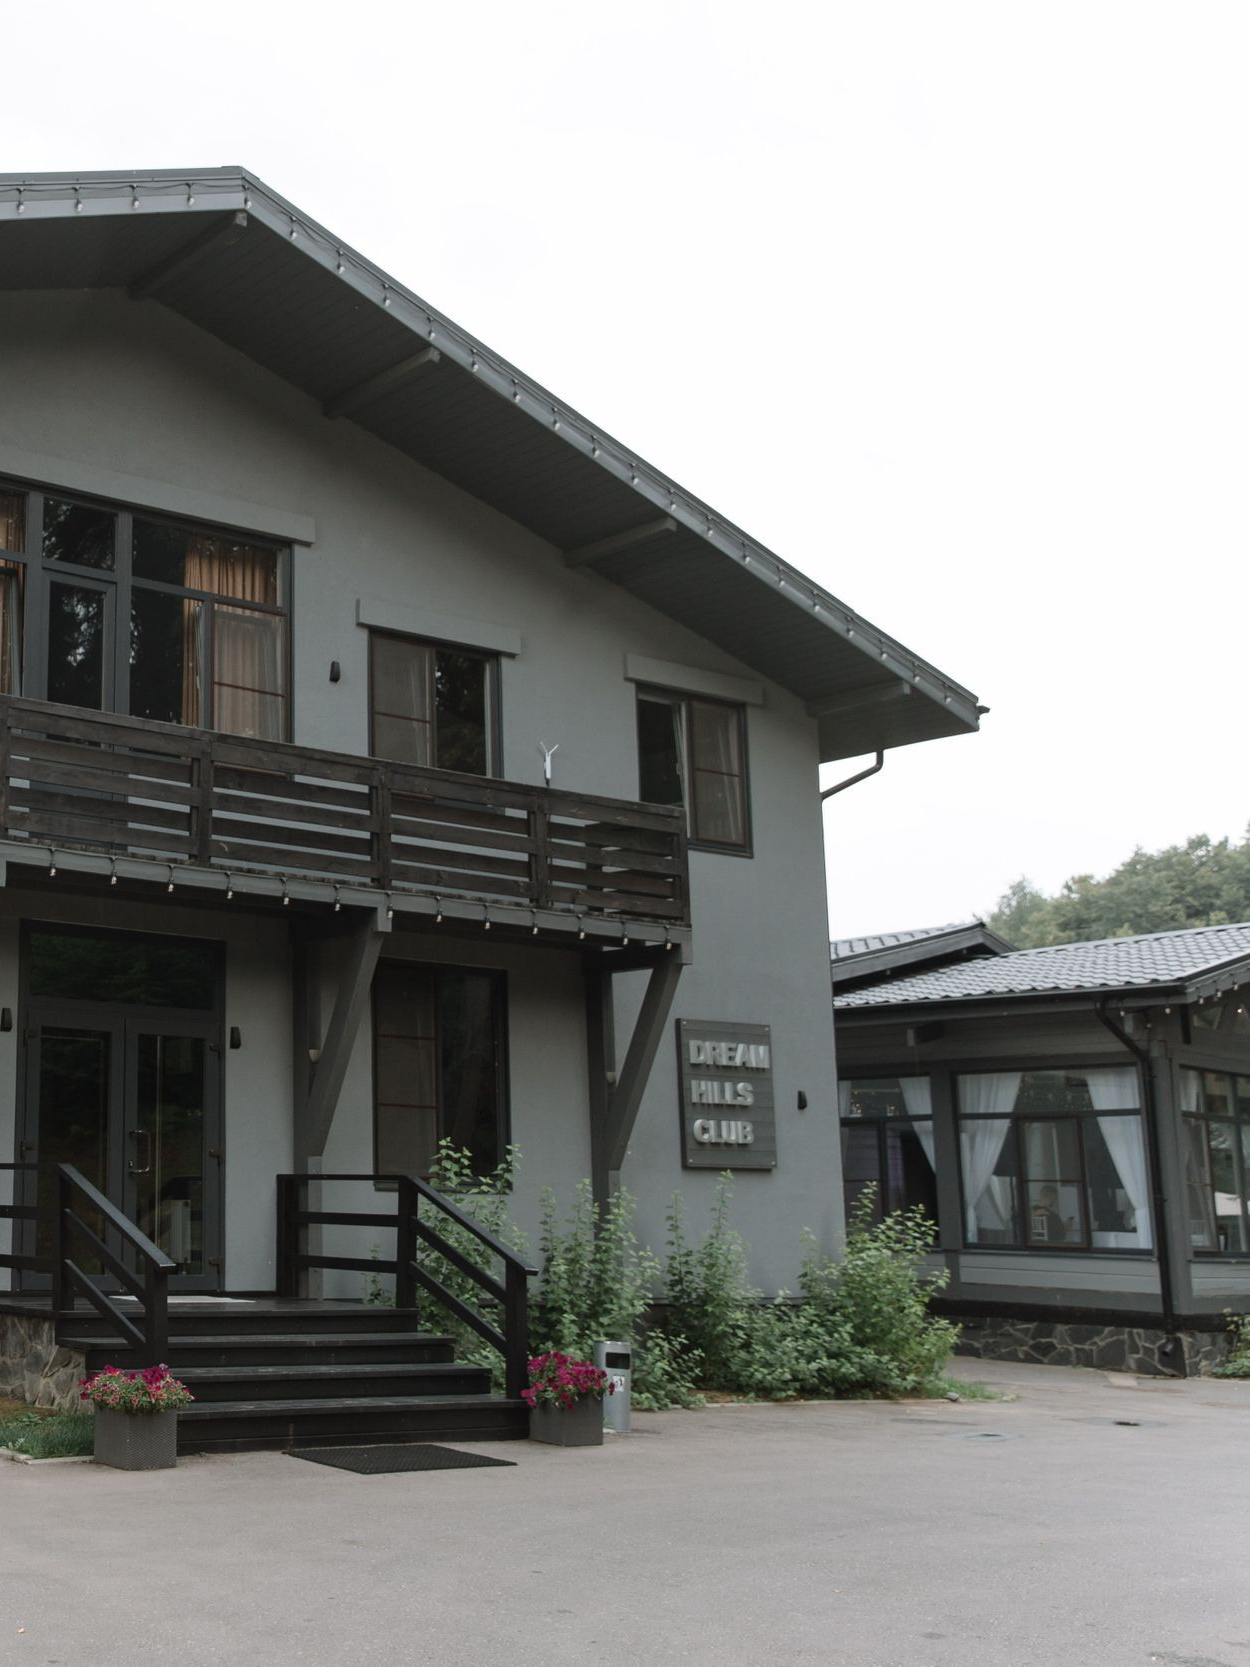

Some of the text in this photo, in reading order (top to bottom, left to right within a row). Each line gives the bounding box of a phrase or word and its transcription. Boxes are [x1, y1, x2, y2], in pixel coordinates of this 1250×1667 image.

[689, 1039, 770, 1068] DREAM
[691, 1079, 754, 1106] HILLS
[693, 1118, 755, 1144] CLUB
